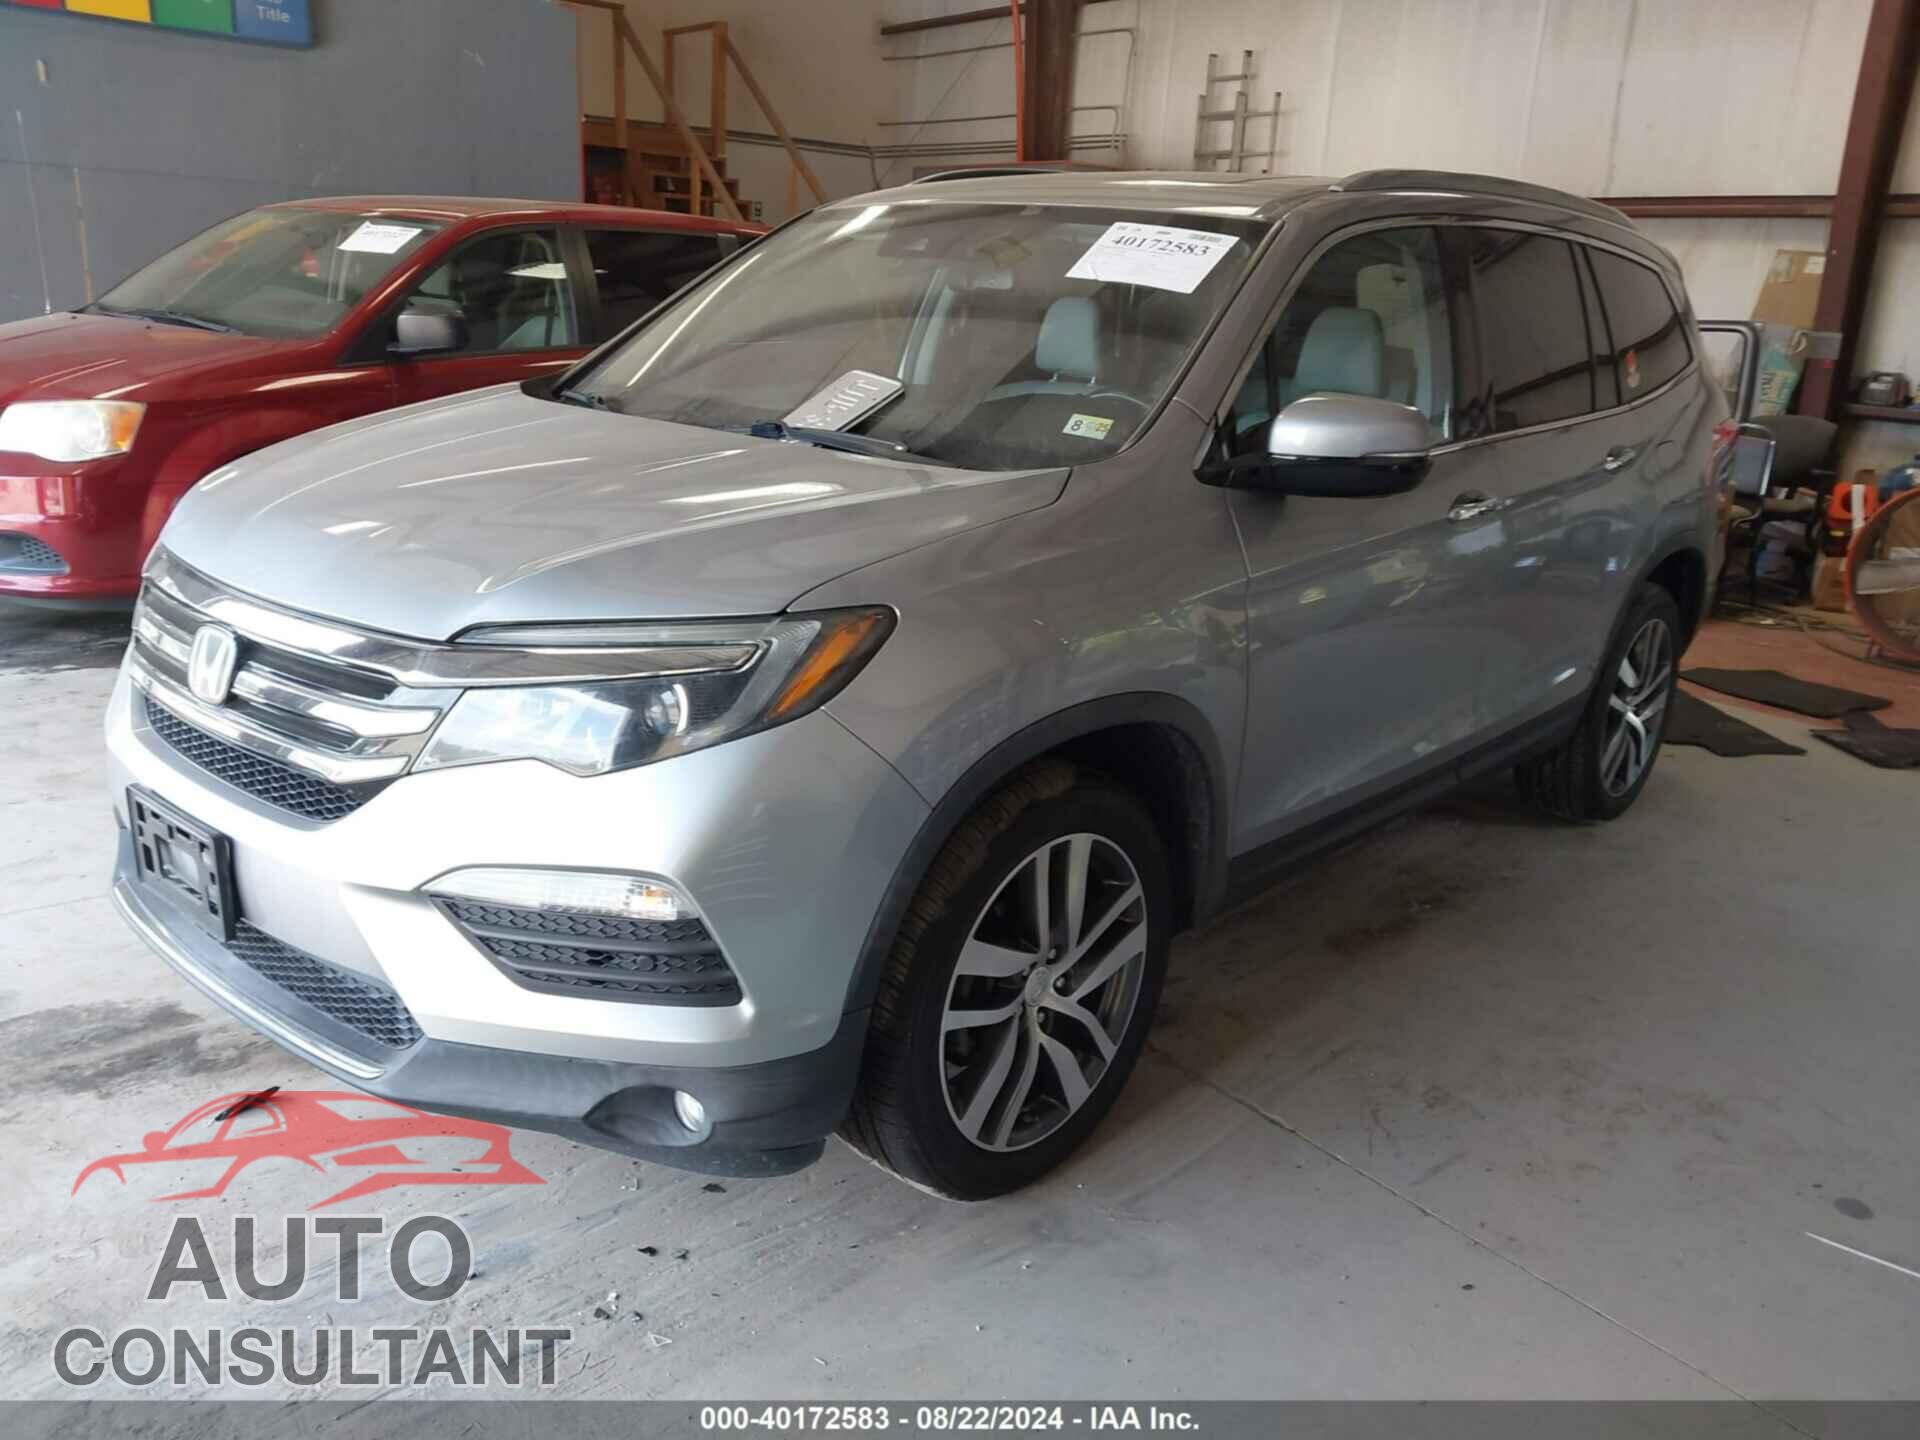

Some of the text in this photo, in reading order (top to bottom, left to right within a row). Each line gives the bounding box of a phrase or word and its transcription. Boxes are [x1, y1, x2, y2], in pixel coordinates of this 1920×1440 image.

[256, 5, 290, 23] Title
[1112, 235, 1210, 257] 40172583
[1071, 419, 1084, 432] 8
